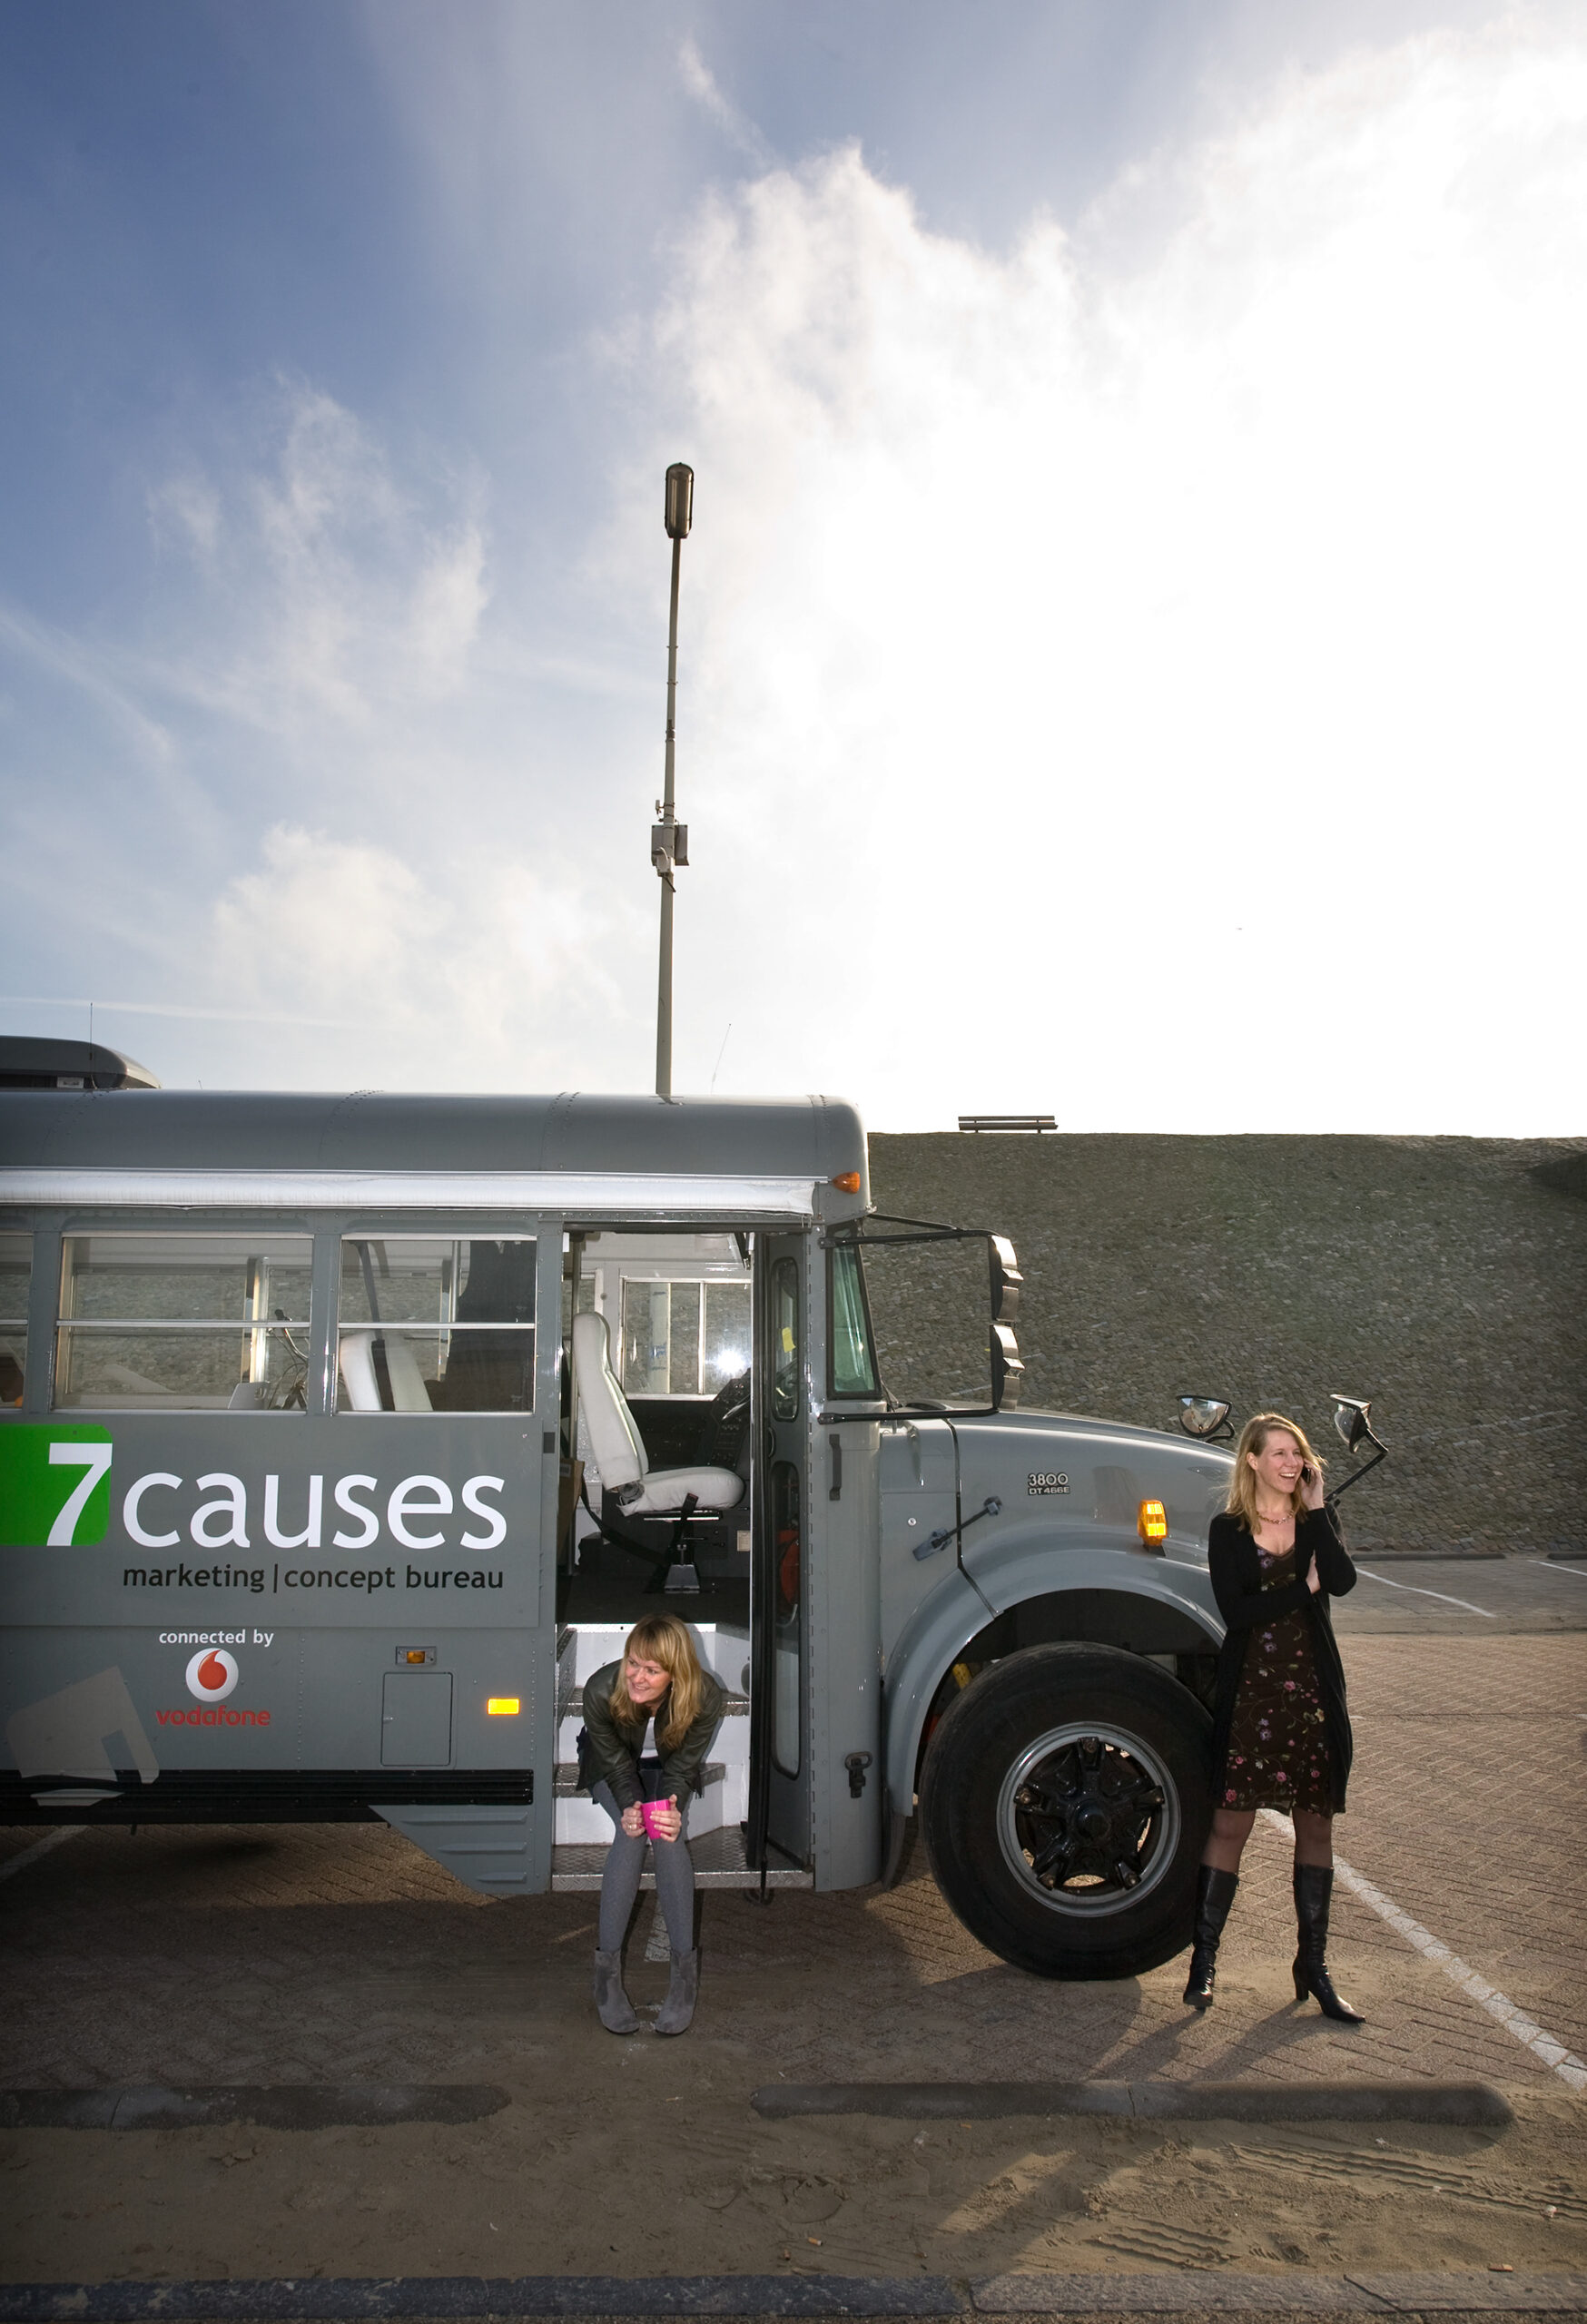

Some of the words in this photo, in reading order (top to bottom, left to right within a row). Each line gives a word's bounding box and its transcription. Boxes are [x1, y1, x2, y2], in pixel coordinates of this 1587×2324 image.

[1028, 1472, 1069, 1487] 3800
[1028, 1486, 1070, 1495] DT466E
[123, 1563, 265, 1593] marketing
[284, 1567, 396, 1594] concept
[406, 1564, 504, 1589] bureau
[159, 1629, 246, 1644] connected
[252, 1629, 274, 1648] by
[155, 1705, 271, 1727] vodafone
